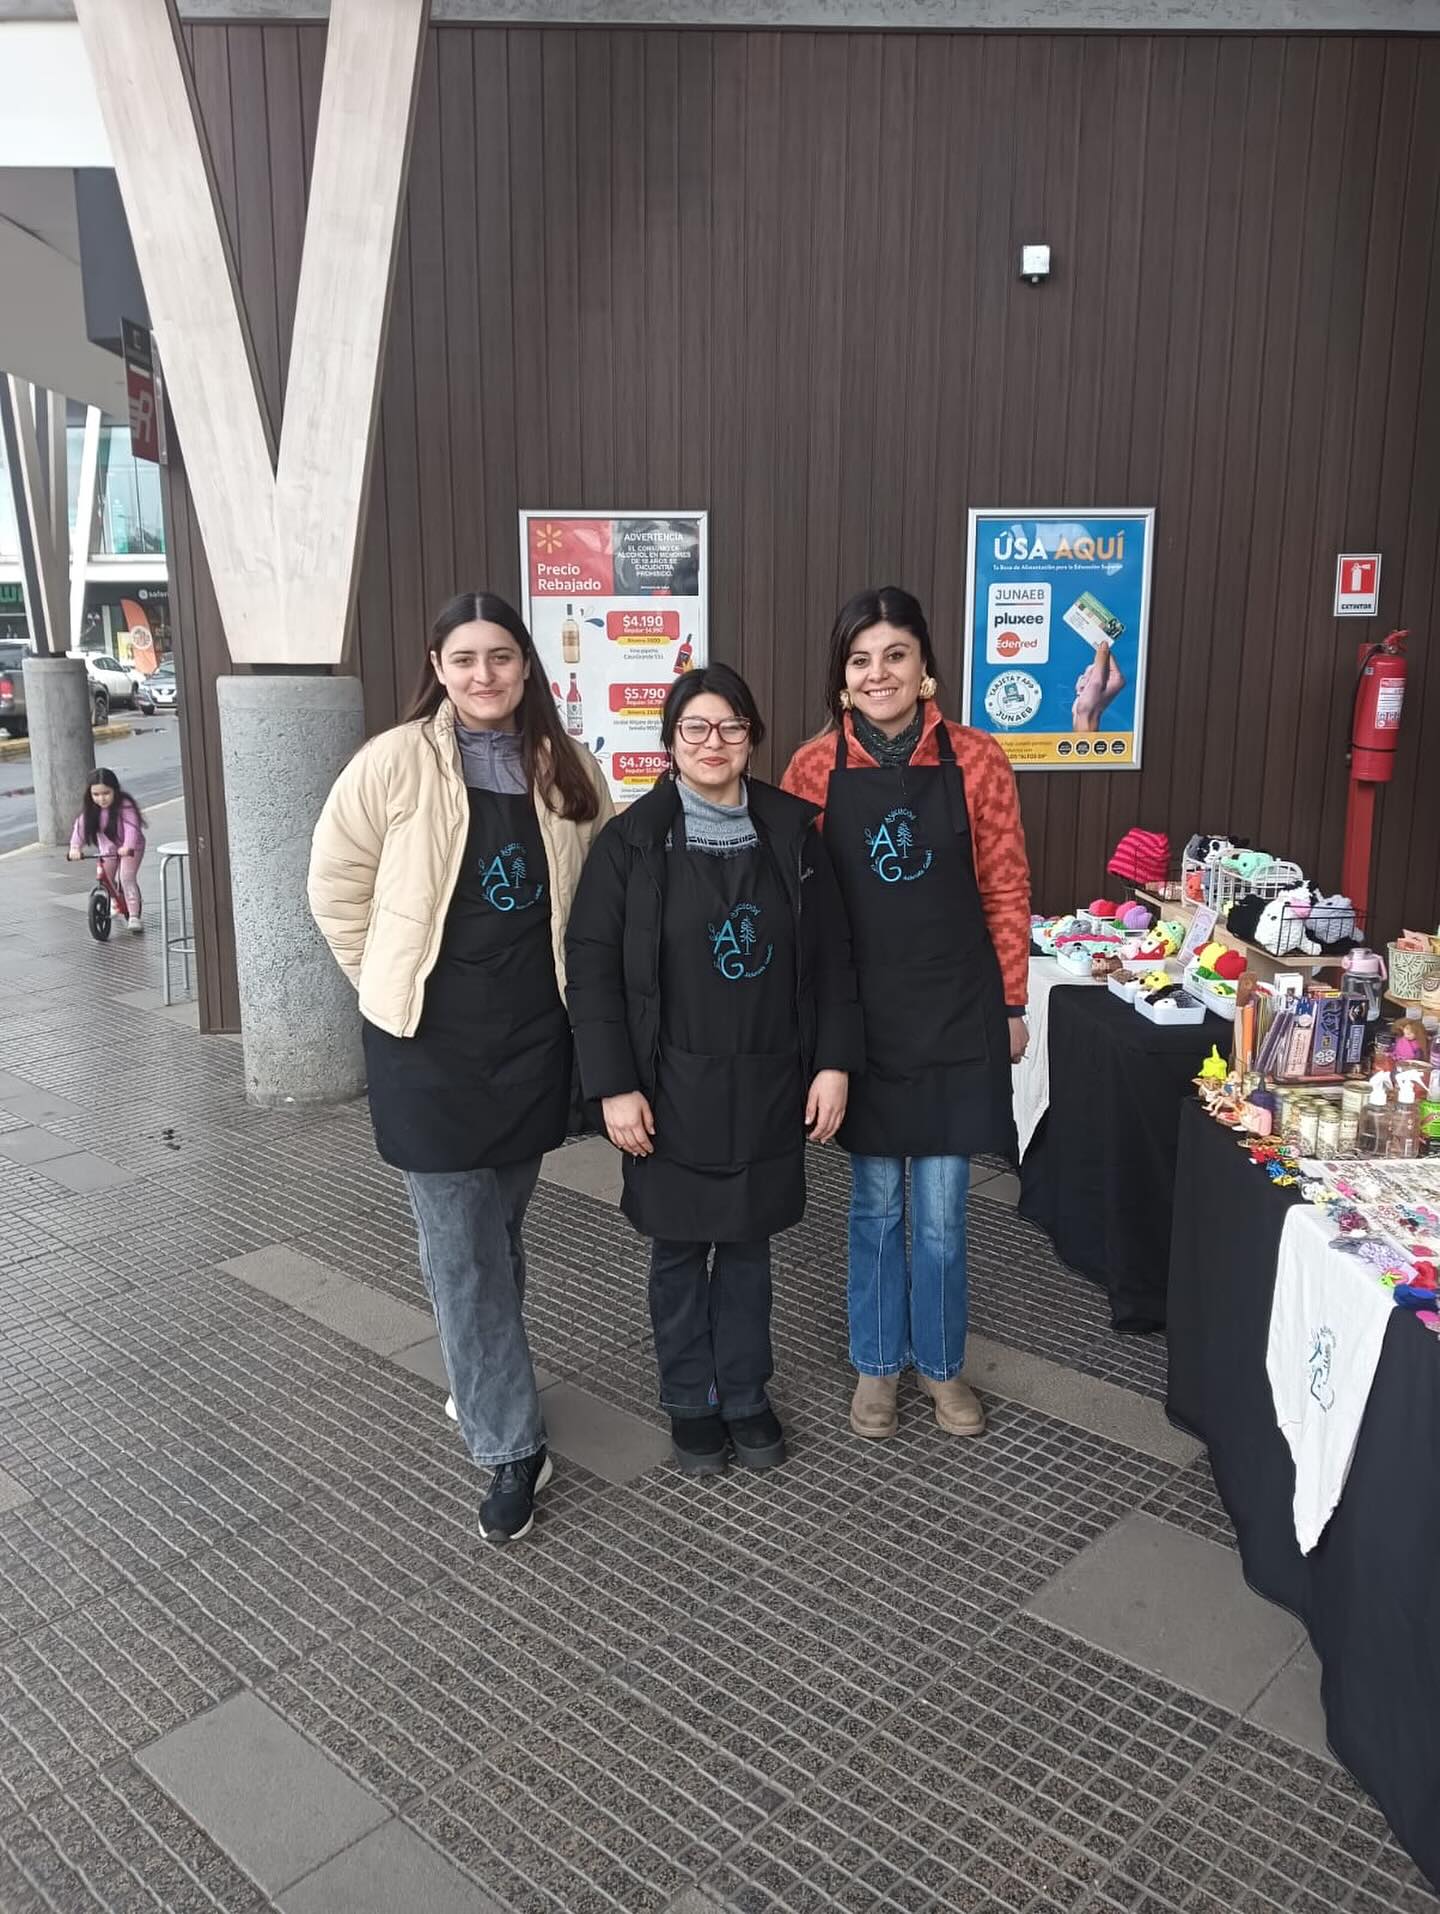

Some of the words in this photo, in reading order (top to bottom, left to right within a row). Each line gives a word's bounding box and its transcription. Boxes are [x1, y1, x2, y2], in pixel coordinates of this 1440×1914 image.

[623, 532, 684, 541] ADVERTENCIA
[994, 530, 1048, 561] ÚSA
[1054, 529, 1125, 561] AQUÍ
[537, 562, 581, 576] Precio
[538, 578, 602, 593] Rebajado
[995, 589, 1045, 600] JUNAEB
[623, 614, 664, 627] $4.190
[994, 612, 1044, 628] pluxee
[994, 639, 1038, 649] Edenred
[990, 675, 1015, 696] TARJETA
[1022, 677, 1035, 690] APP
[624, 688, 666, 700] $5.790
[996, 706, 1034, 722] JUNAEB
